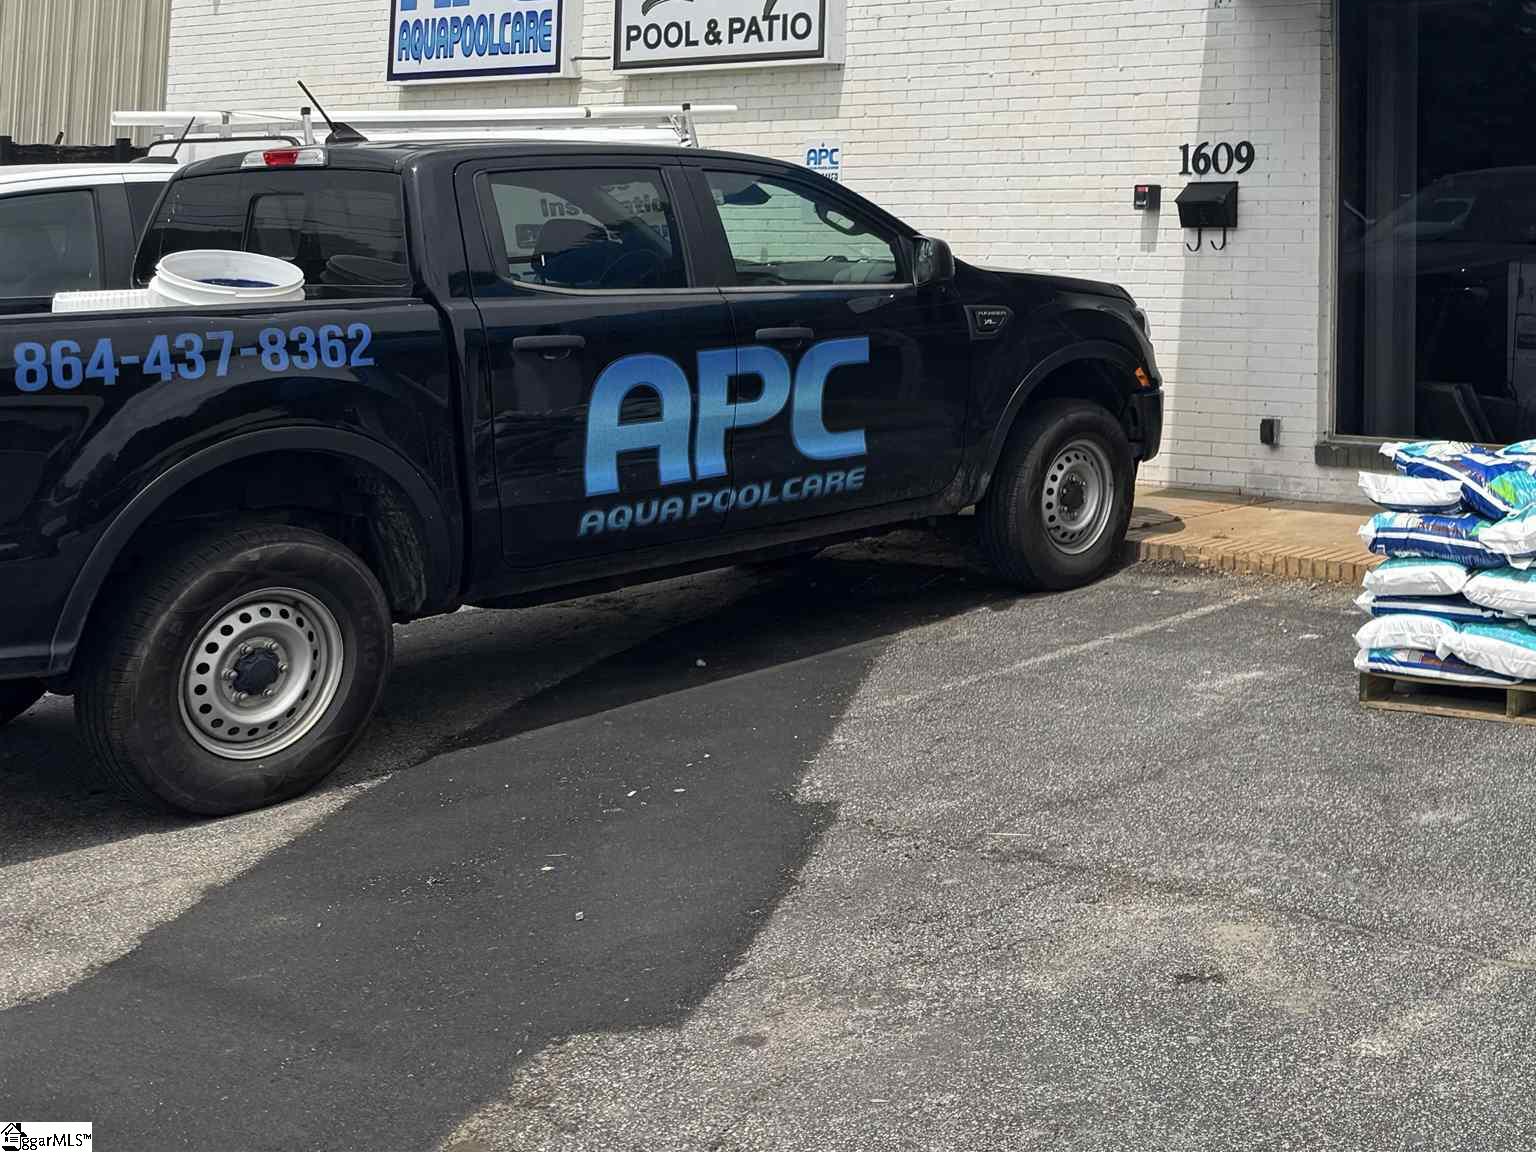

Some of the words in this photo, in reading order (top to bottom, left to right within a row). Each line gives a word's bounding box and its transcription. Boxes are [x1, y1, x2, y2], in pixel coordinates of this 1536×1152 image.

[397, 9, 553, 64] AQUAPOOLCARE
[625, 20, 699, 51] POOL
[704, 18, 722, 46] &
[728, 11, 812, 44] PATIO
[806, 148, 839, 165] APC
[1178, 140, 1255, 175] 1609
[13, 322, 375, 392] 864-437-8362
[584, 336, 870, 497] APC
